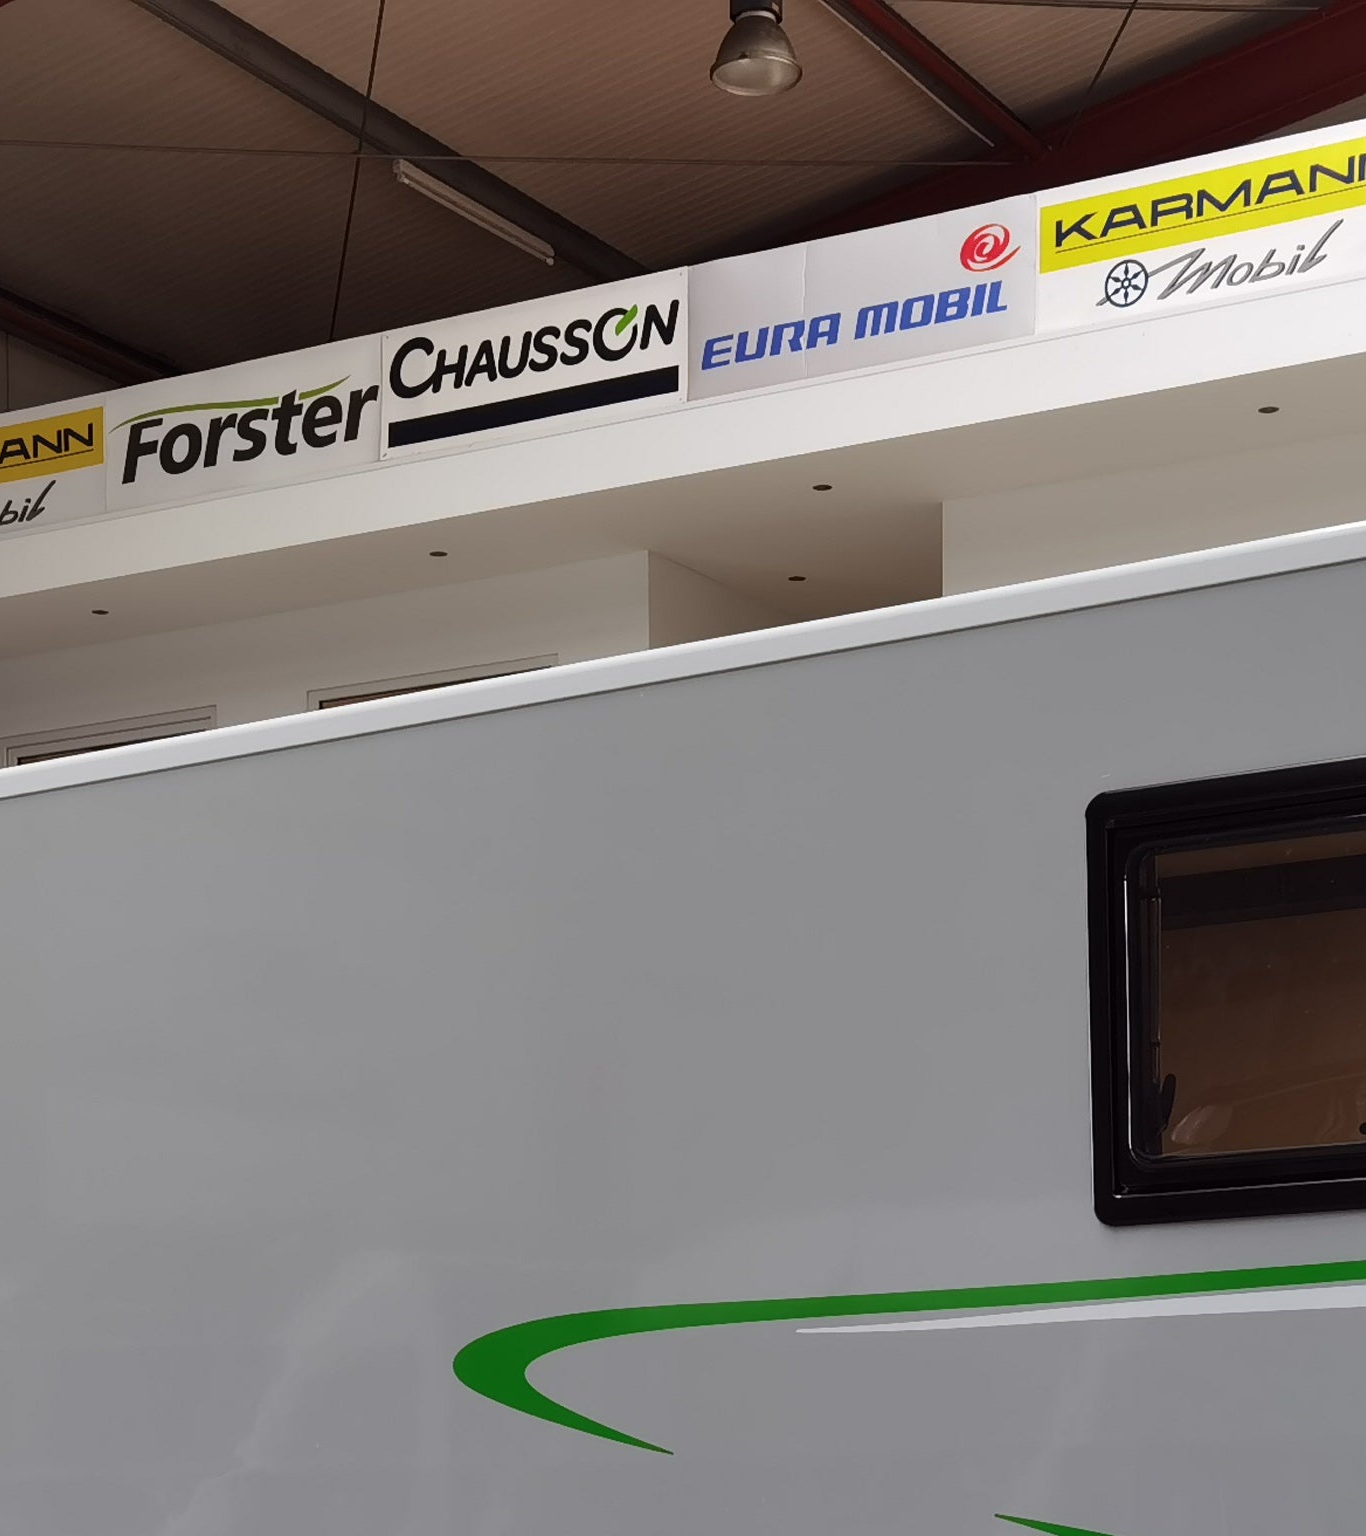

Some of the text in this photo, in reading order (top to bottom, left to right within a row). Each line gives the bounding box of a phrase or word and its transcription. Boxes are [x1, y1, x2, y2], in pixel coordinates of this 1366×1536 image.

[1149, 219, 1344, 302] Mobil
[390, 299, 681, 399] CHAUSSON
[700, 280, 1009, 371] EURA MOBIL
[121, 382, 380, 485] Forster
